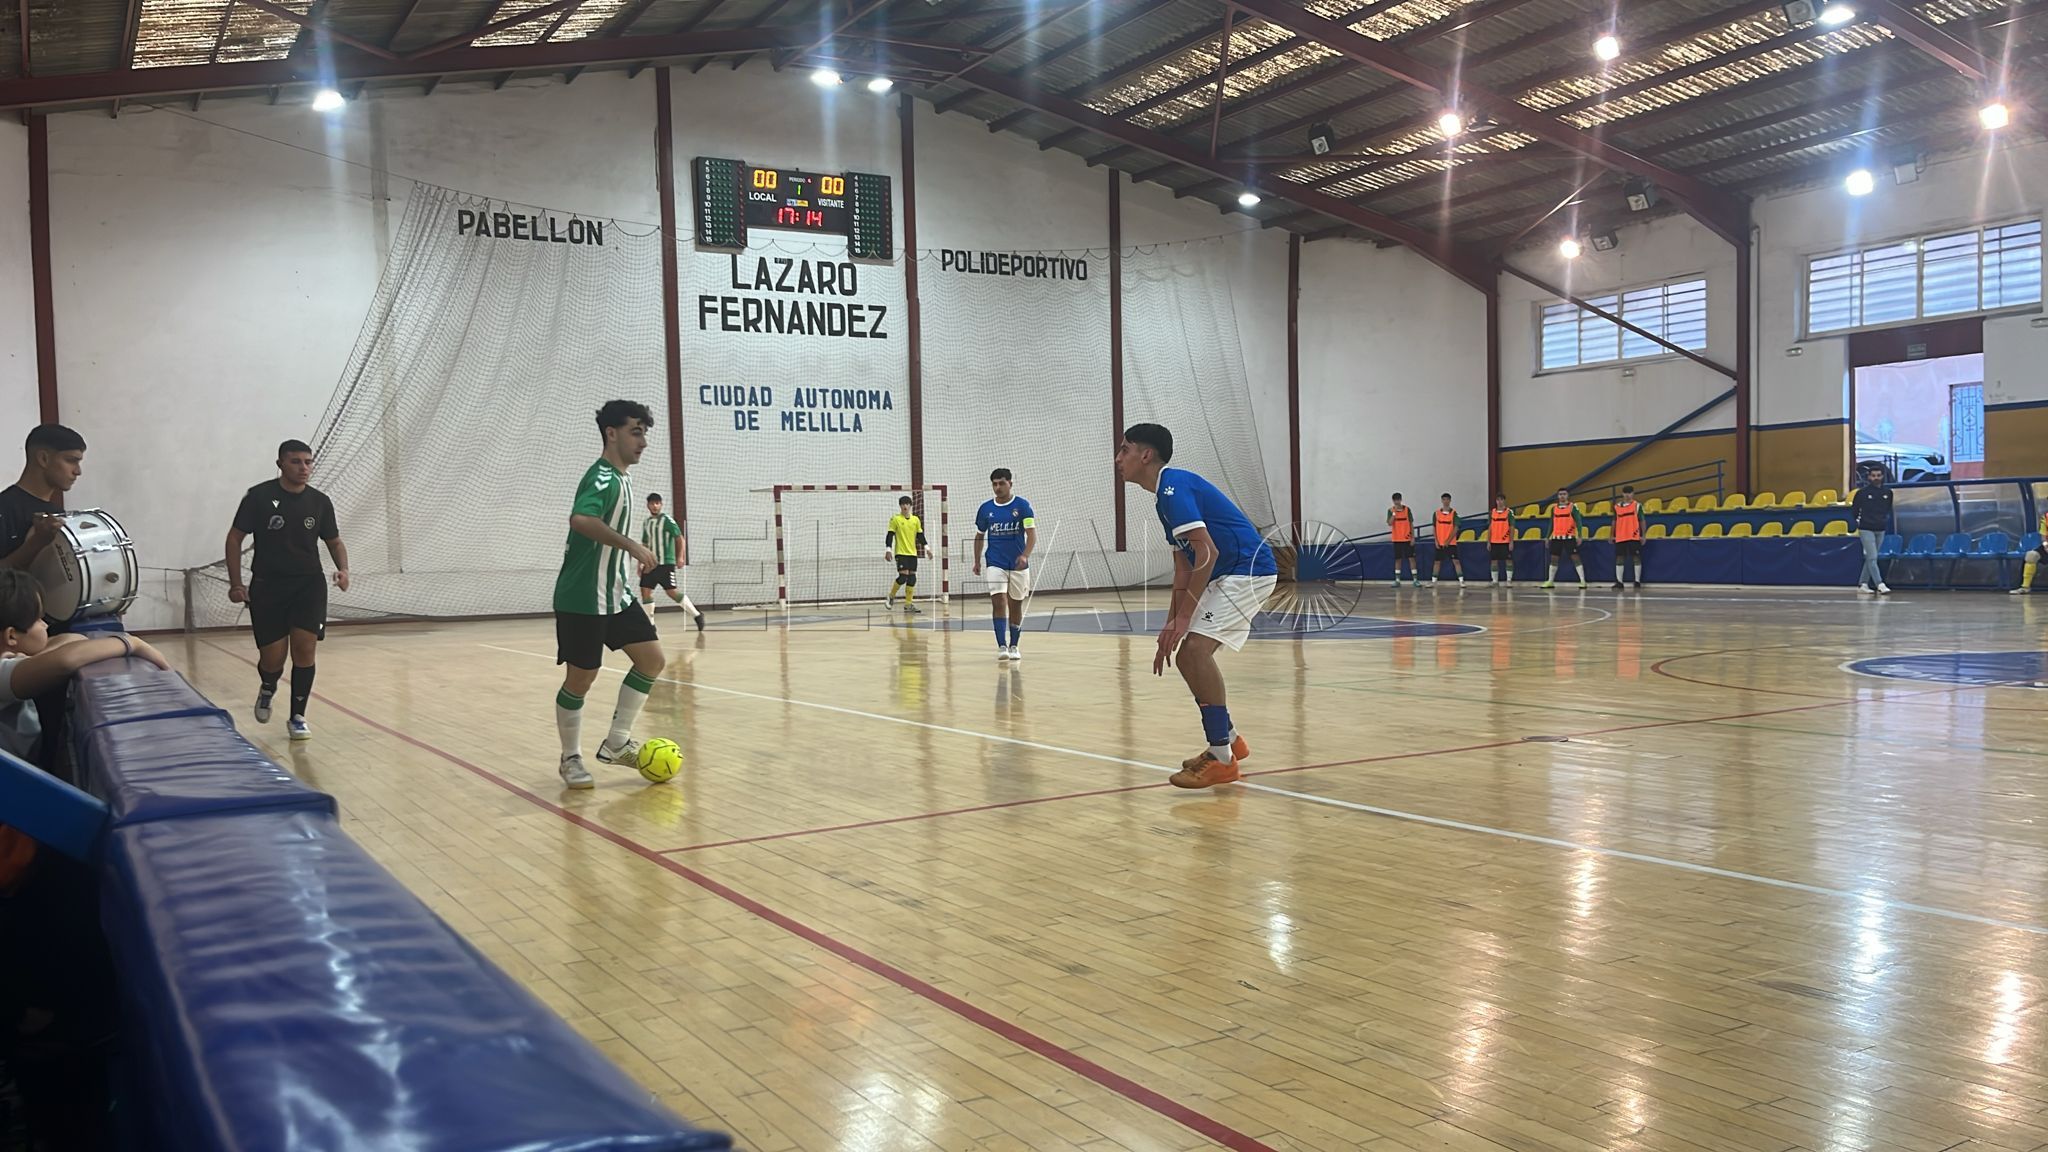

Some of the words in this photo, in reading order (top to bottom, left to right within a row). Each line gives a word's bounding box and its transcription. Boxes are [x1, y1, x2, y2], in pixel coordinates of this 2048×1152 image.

[753, 169, 778, 189] 00
[797, 184, 802, 196] 1
[820, 175, 845, 196] 00
[748, 191, 777, 203] LOCAL
[817, 197, 845, 209] VISITANTE
[457, 209, 604, 247] PABELLON
[731, 253, 858, 297] LAZARO
[941, 248, 1088, 281] POLIDEPORTIVO
[698, 294, 888, 339] FERNANDEZ
[699, 384, 773, 407] CIUDAD
[793, 386, 894, 411] AUTONOMA
[733, 410, 761, 431] DE
[780, 410, 864, 433] MELILLA
